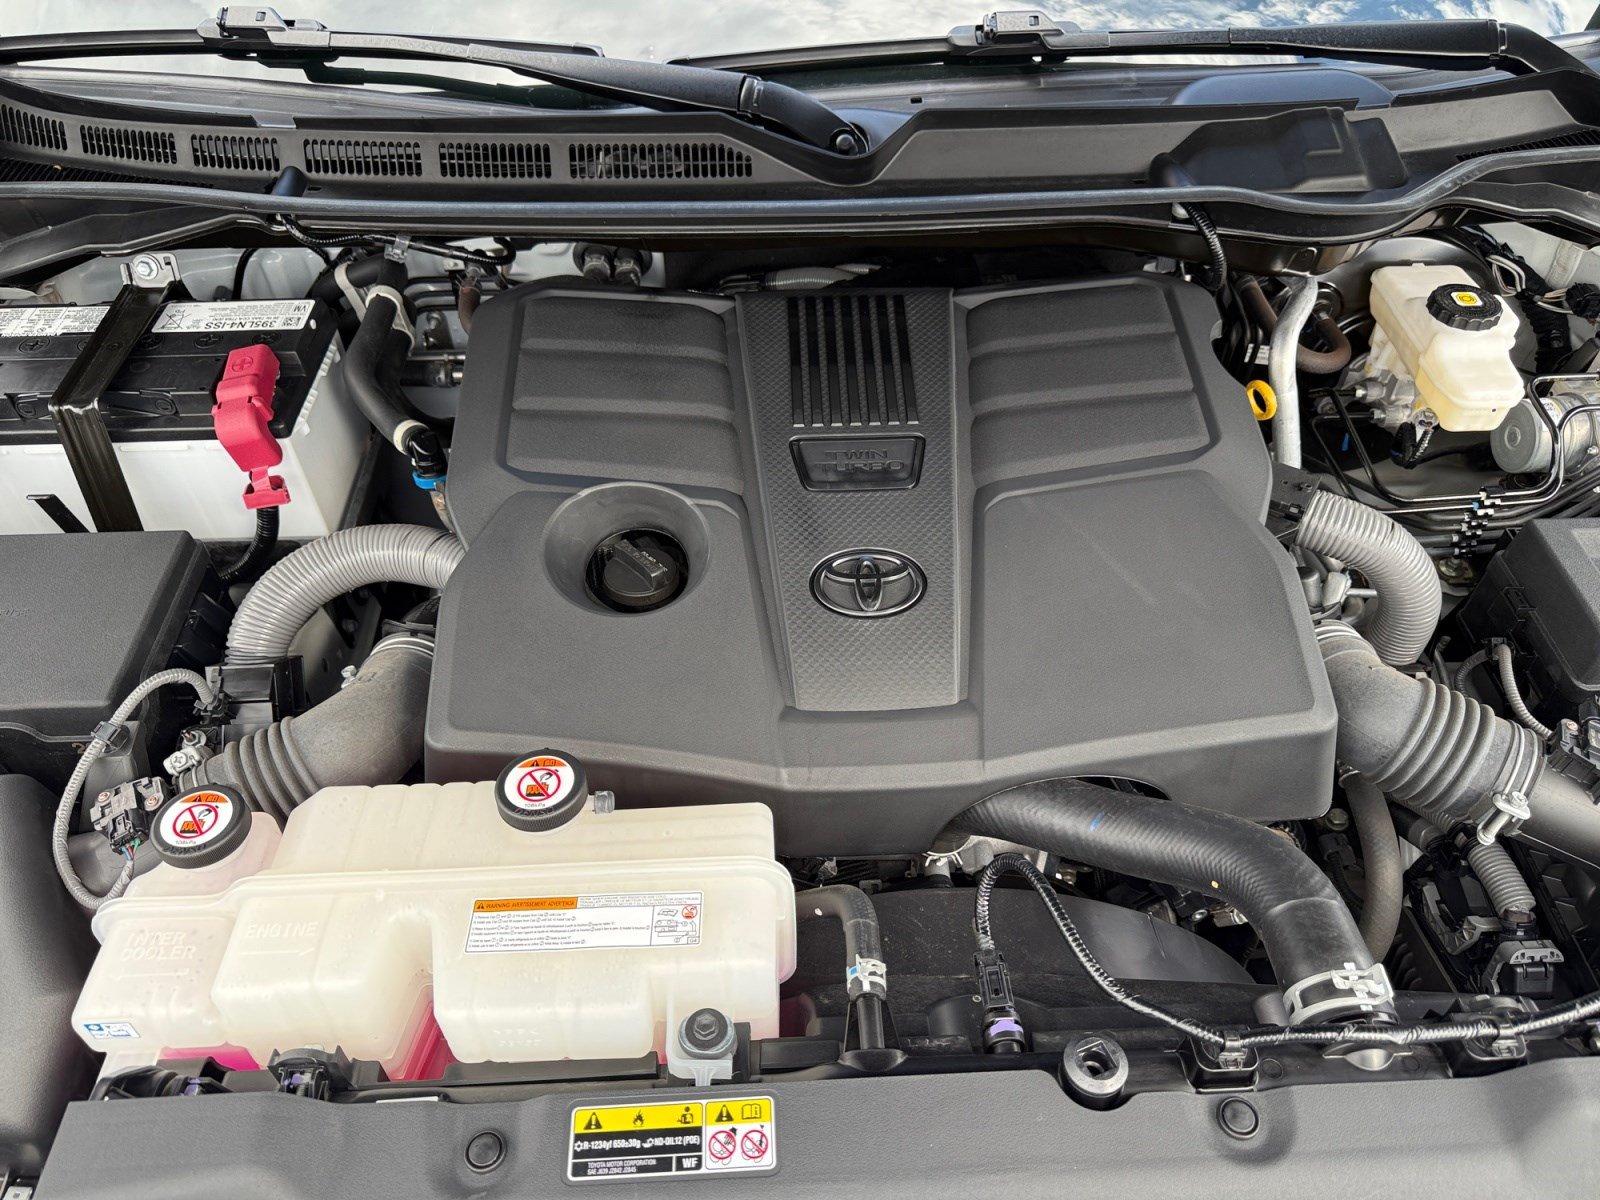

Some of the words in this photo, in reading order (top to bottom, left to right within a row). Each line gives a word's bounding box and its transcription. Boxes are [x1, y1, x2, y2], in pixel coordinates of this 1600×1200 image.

[204, 320, 277, 330] 395LN4-ISS
[824, 449, 888, 460] TWIN
[815, 460, 905, 472] TURBO
[244, 921, 319, 939] ENGINE
[125, 931, 187, 946] INTER
[119, 946, 197, 961] COOLER
[583, 1140, 612, 1150] R-1234yf
[683, 1135, 700, 1146] (POE)
[606, 1160, 623, 1168] MOTOR
[623, 1159, 657, 1167] CORPORATION
[682, 1158, 698, 1168] WF
